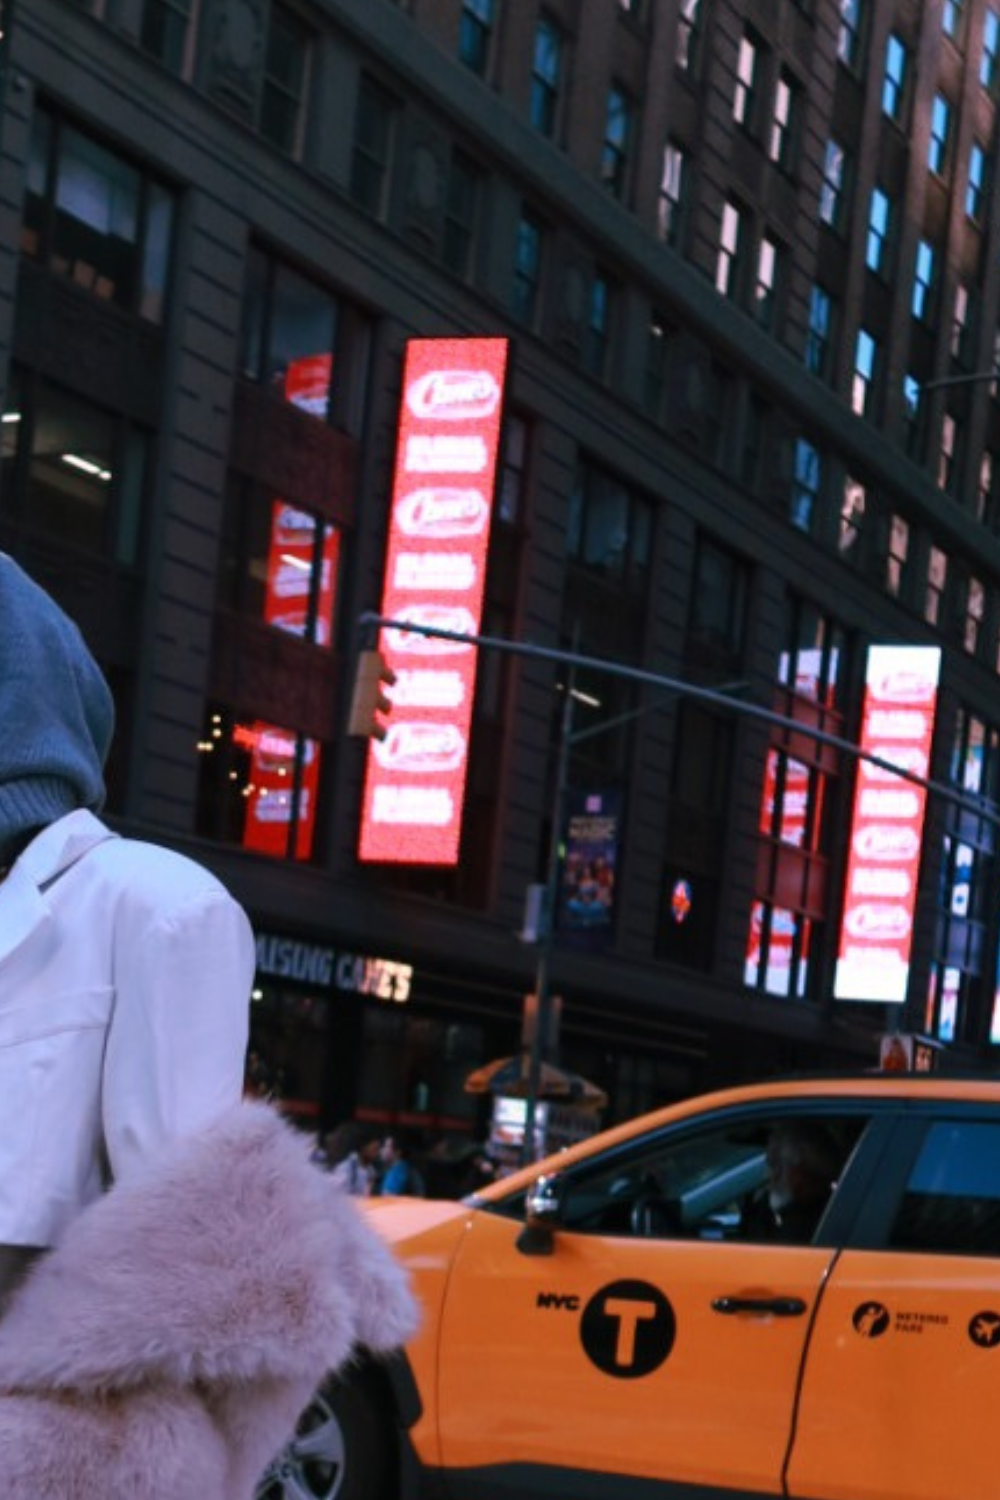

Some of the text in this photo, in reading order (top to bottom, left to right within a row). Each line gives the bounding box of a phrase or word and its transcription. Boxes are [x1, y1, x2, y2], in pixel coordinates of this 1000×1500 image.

[256, 934, 334, 986] AISING
[537, 1292, 656, 1366] NYC T
